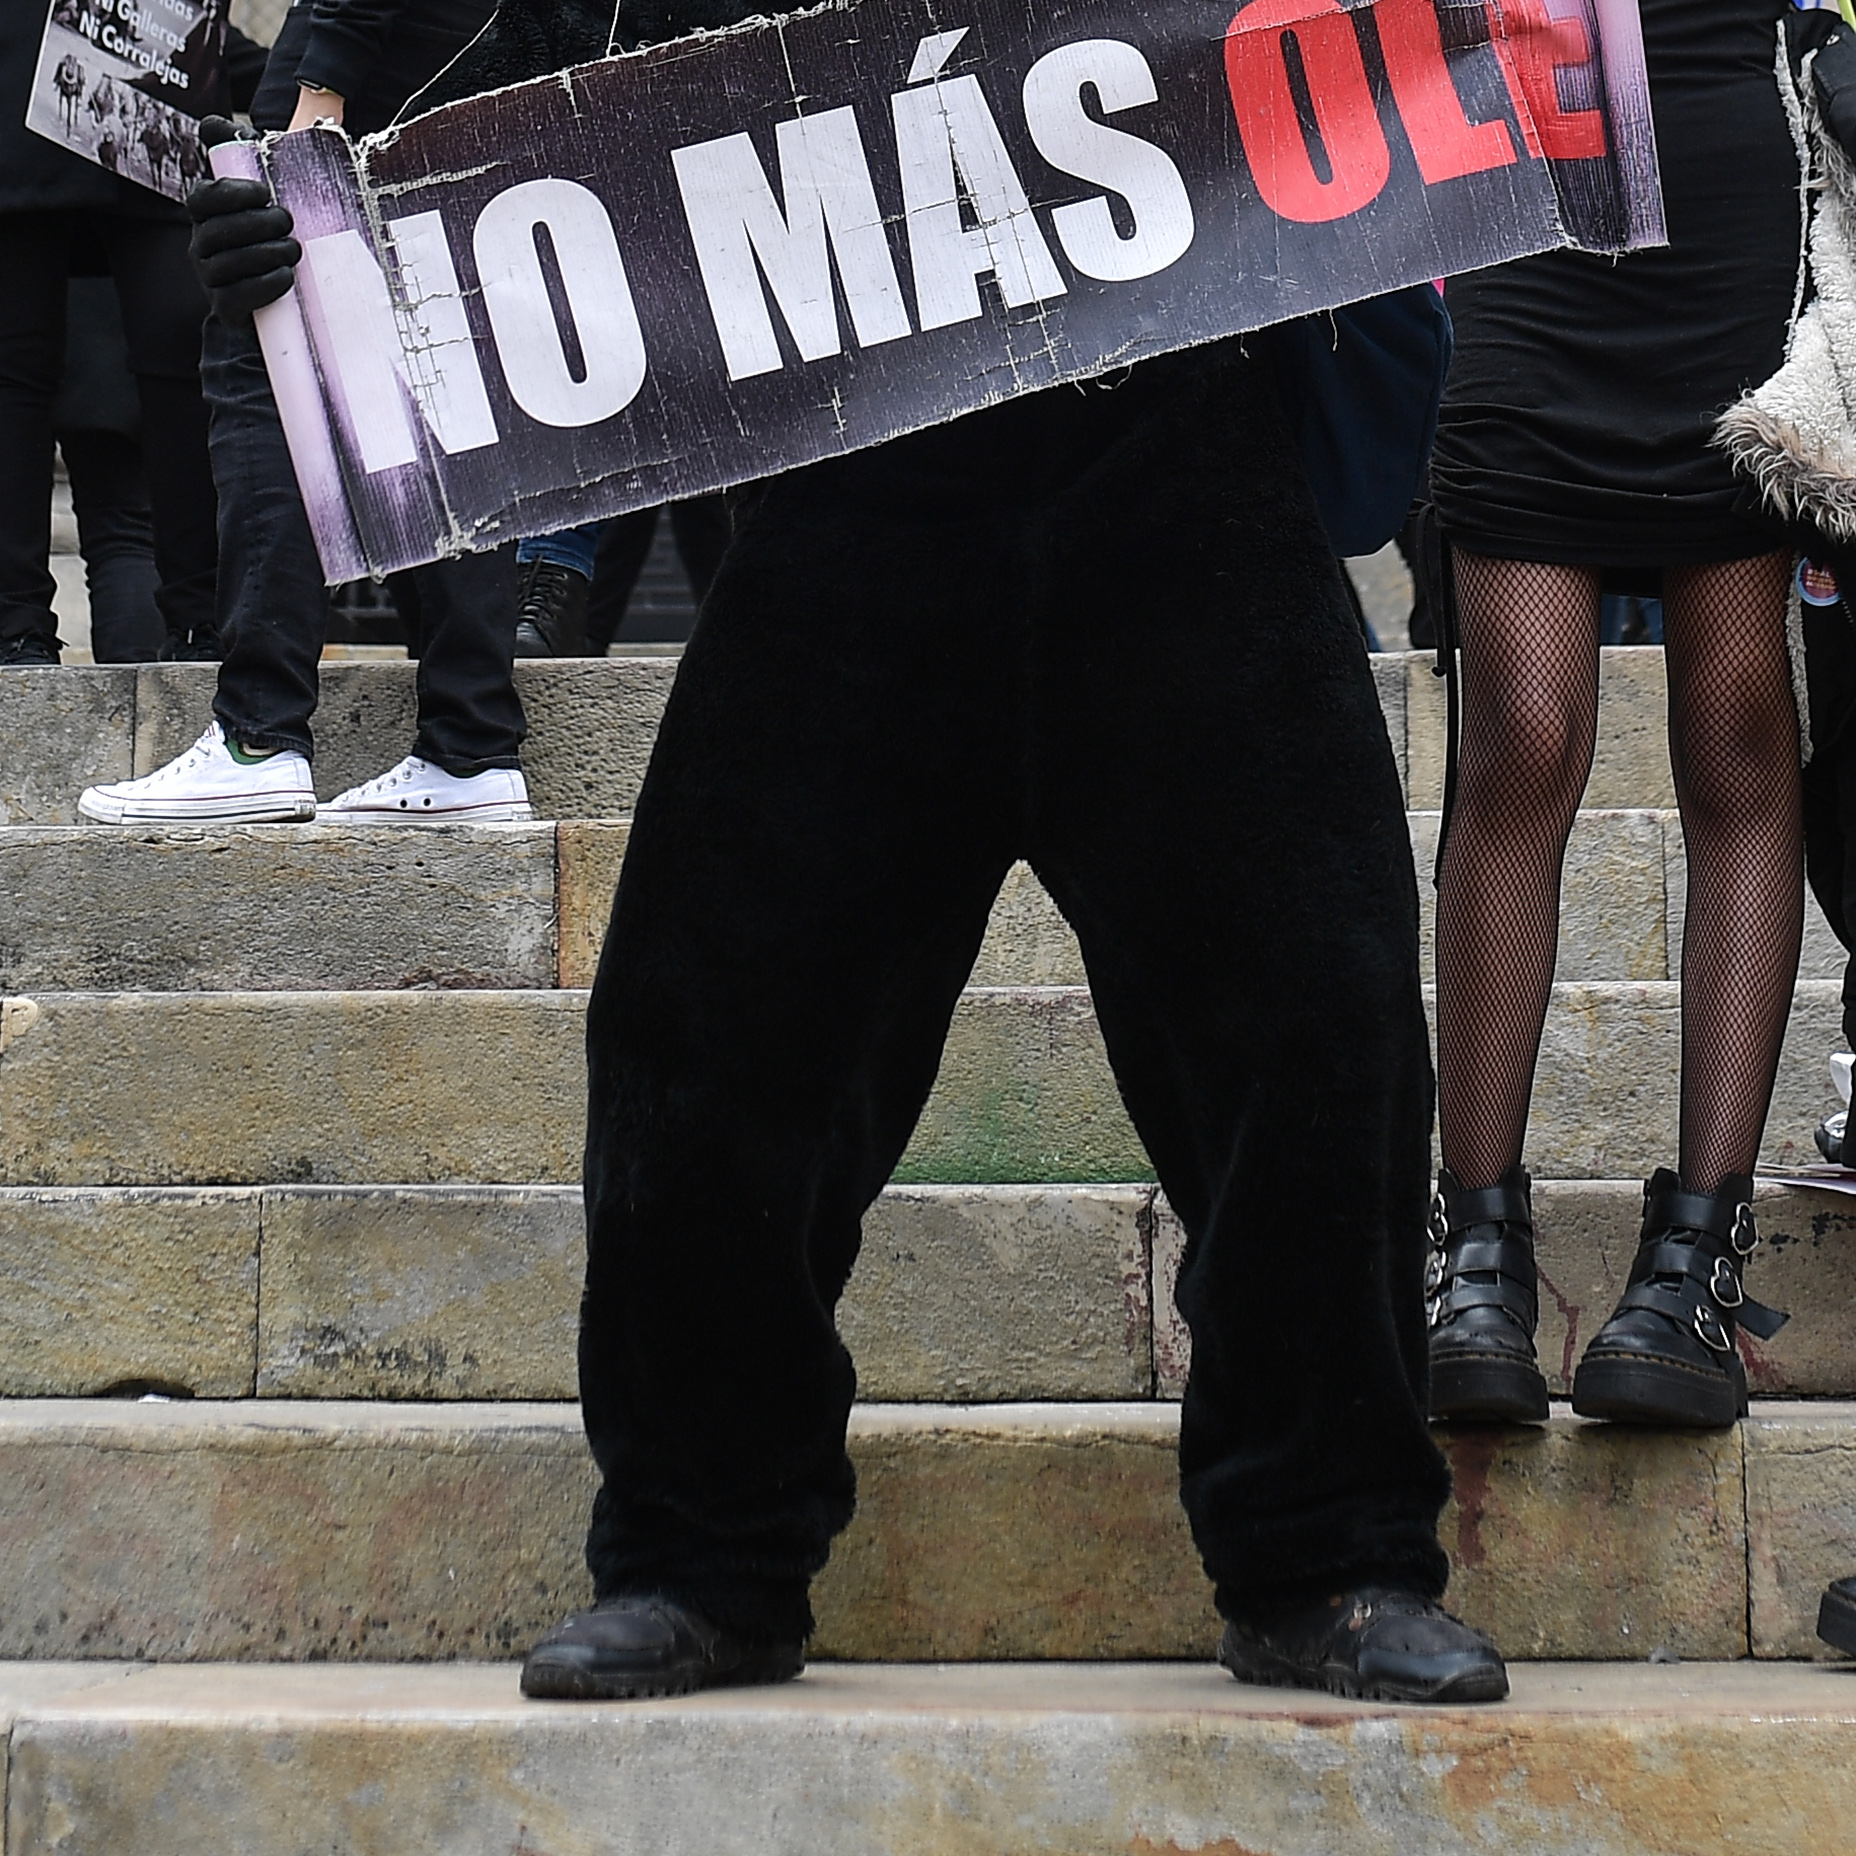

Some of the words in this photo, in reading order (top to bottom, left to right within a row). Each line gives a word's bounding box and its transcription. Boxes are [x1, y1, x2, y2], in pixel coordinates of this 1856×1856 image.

[79, 10, 101, 41] Ni
[102, 24, 191, 90] Corralejas
[304, 177, 646, 474] NO
[670, 25, 1196, 381] MÁS
